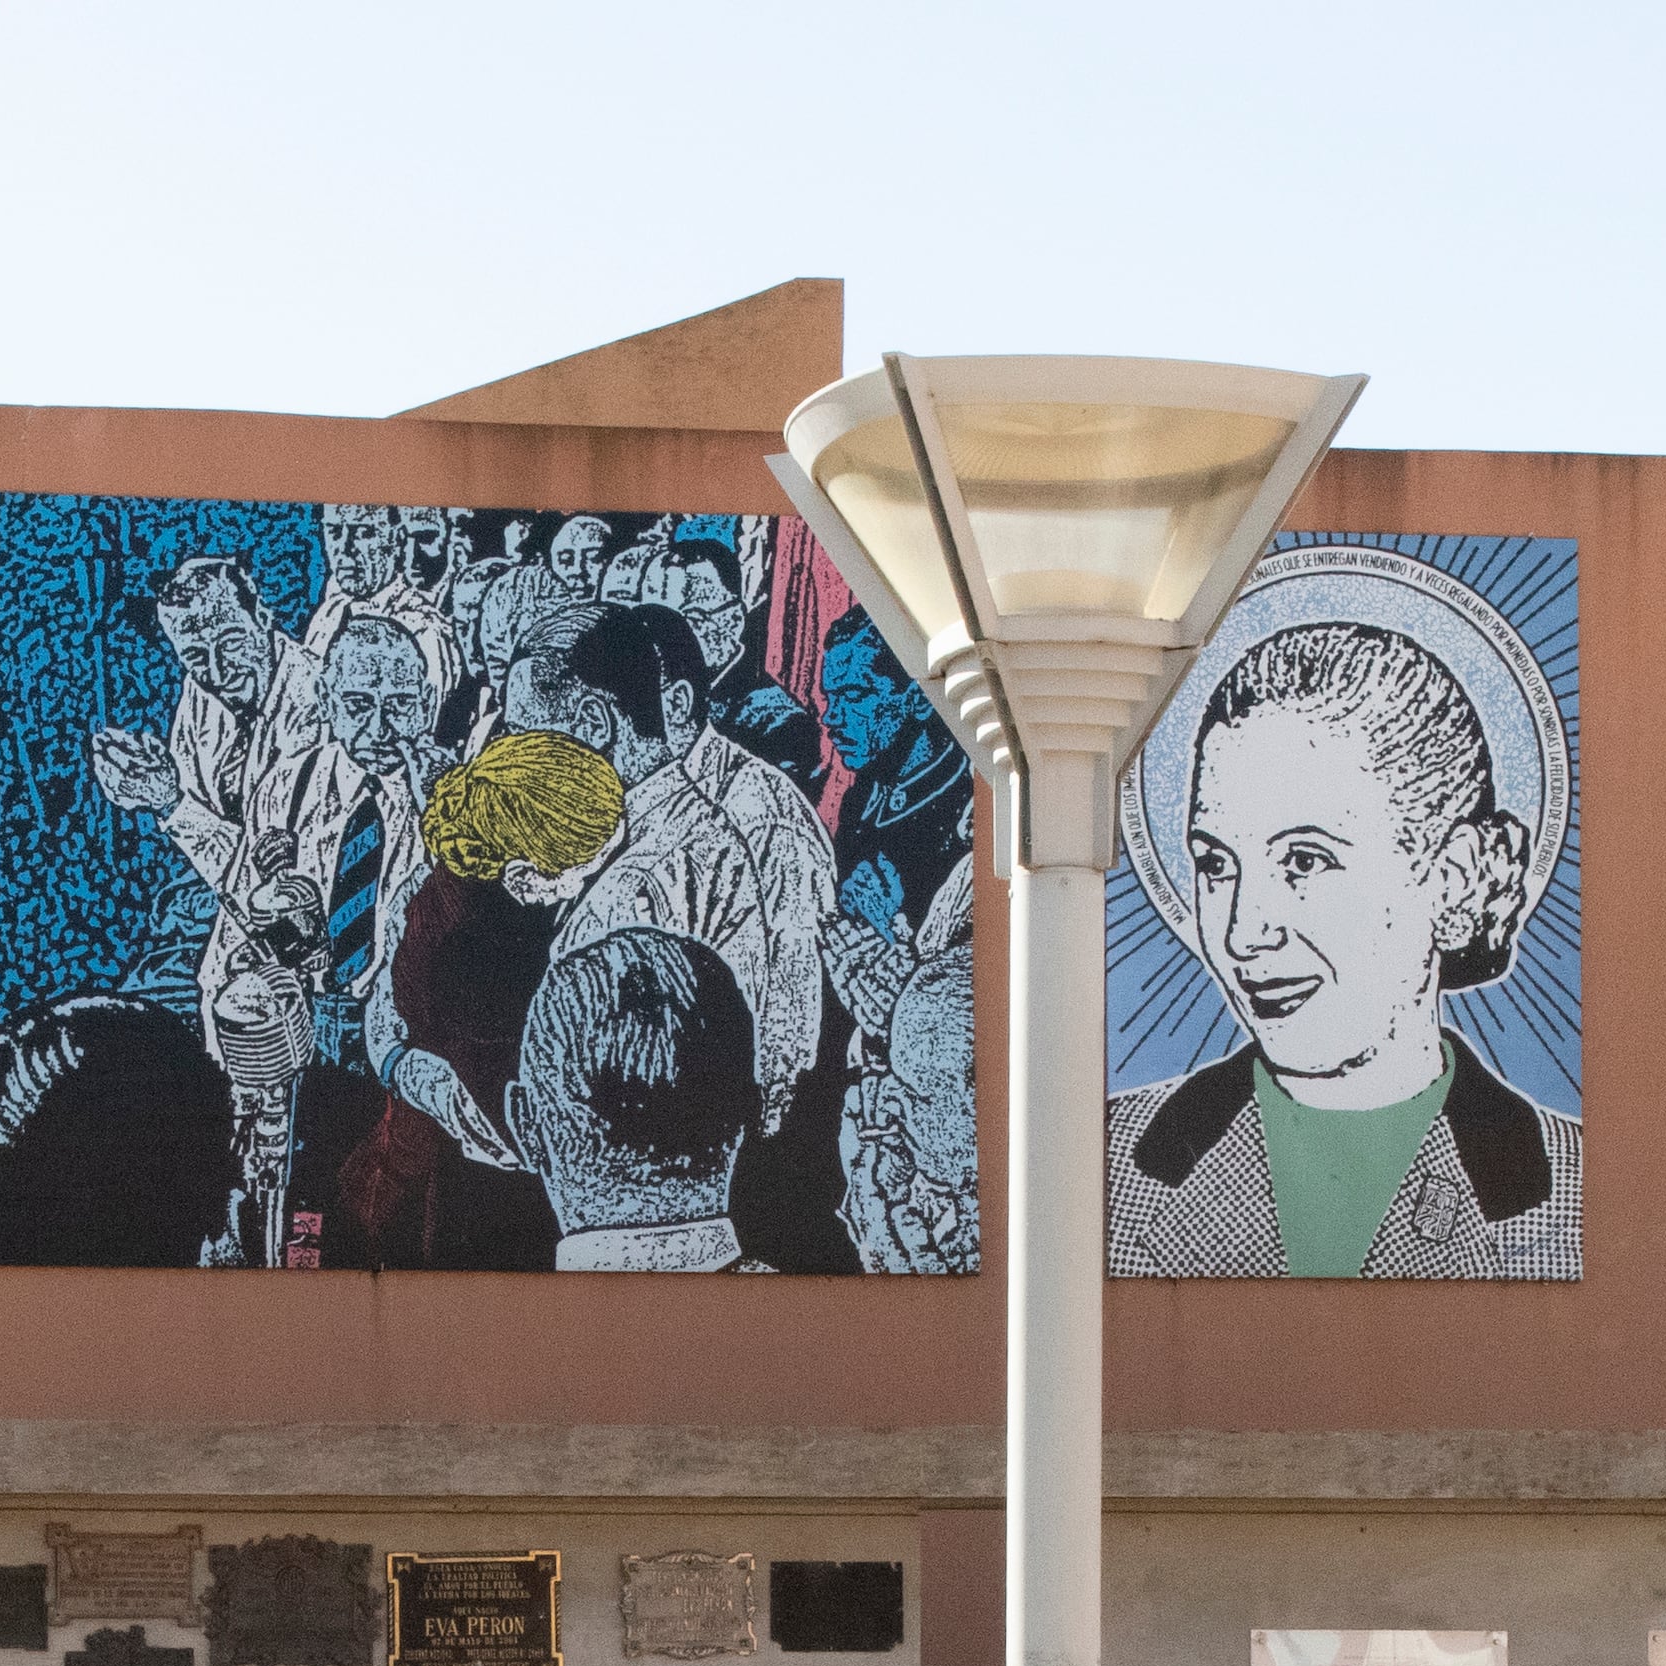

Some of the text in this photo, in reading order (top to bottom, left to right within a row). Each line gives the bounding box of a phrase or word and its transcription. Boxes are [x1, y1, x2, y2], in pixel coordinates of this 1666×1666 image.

[1283, 555, 1301, 571] QUE
[1303, 553, 1313, 568] SE
[1313, 552, 1358, 567] ENTREGAN
[1359, 554, 1407, 575] VENDIENDO
[1409, 565, 1417, 579] Y
[1416, 568, 1426, 583] A
[1425, 572, 1451, 594] VECES
[1447, 585, 1493, 628] REGALANDO
[1490, 620, 1510, 643] POR
[1504, 639, 1535, 679] MONEDAS
[1526, 677, 1537, 691] O
[1533, 684, 1548, 706] POR
[1538, 704, 1560, 749] SONRISAS
[1548, 750, 1560, 763] LA
[1549, 762, 1564, 807] FELICIDAD
[1124, 792, 1138, 812] LOS
[1127, 812, 1142, 833] QUE
[1547, 808, 1562, 823] DE
[1545, 822, 1561, 839] SUS
[1137, 853, 1175, 909] ABOMINABLE
[425, 1616, 525, 1636] EVA PERON
